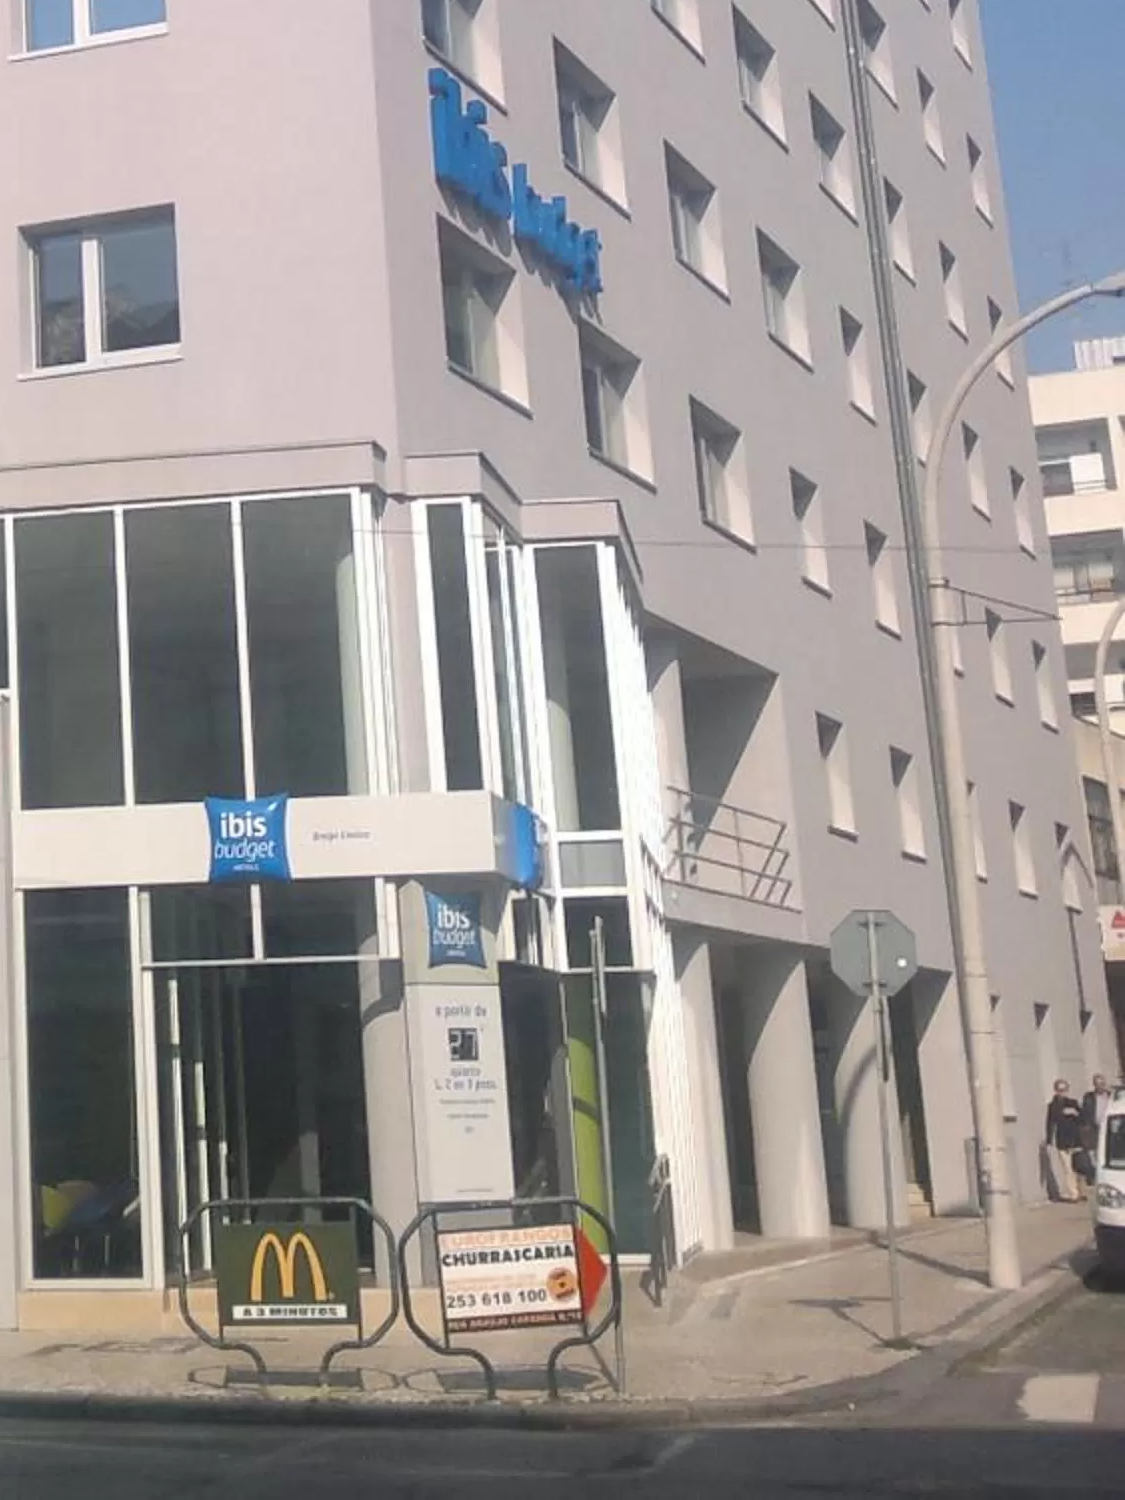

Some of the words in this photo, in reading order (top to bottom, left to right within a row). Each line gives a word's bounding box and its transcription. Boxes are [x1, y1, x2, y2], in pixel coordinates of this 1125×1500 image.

[220, 810, 267, 838] ibis
[214, 838, 276, 862] budget
[437, 903, 471, 928] ibis
[442, 1244, 574, 1267] CHURRASCARIA
[447, 1293, 476, 1309] 253
[518, 1288, 547, 1303] 100
